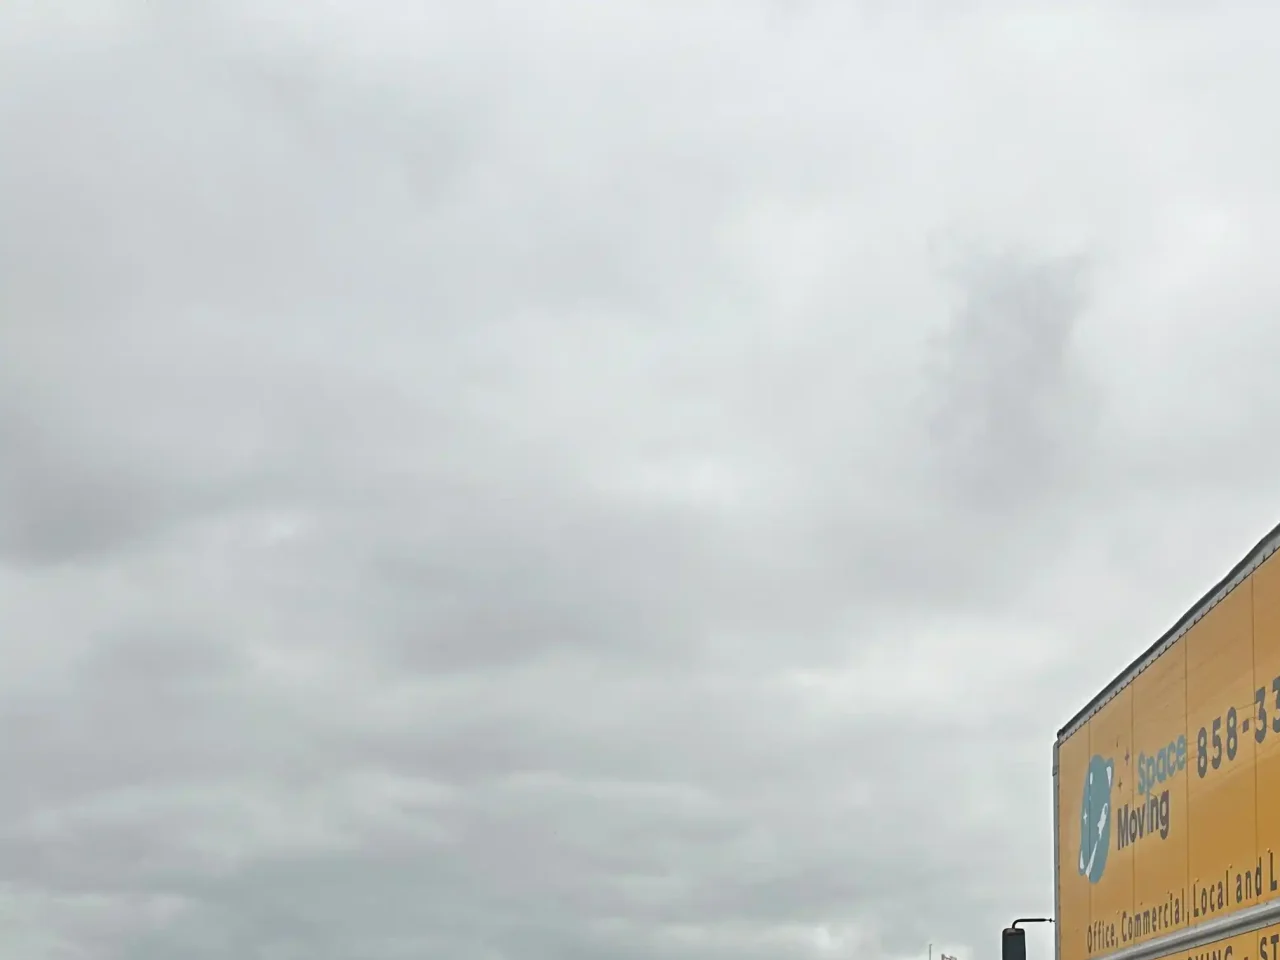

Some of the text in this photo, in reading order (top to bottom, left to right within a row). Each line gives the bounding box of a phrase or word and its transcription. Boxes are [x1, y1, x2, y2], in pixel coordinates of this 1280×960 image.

[1137, 734, 1187, 796] Space
[1117, 789, 1170, 851] Moving
[1087, 921, 1119, 953] Office,
[1121, 888, 1190, 942] Commercial,
[1193, 870, 1229, 917] Local
[1236, 857, 1262, 903] and
